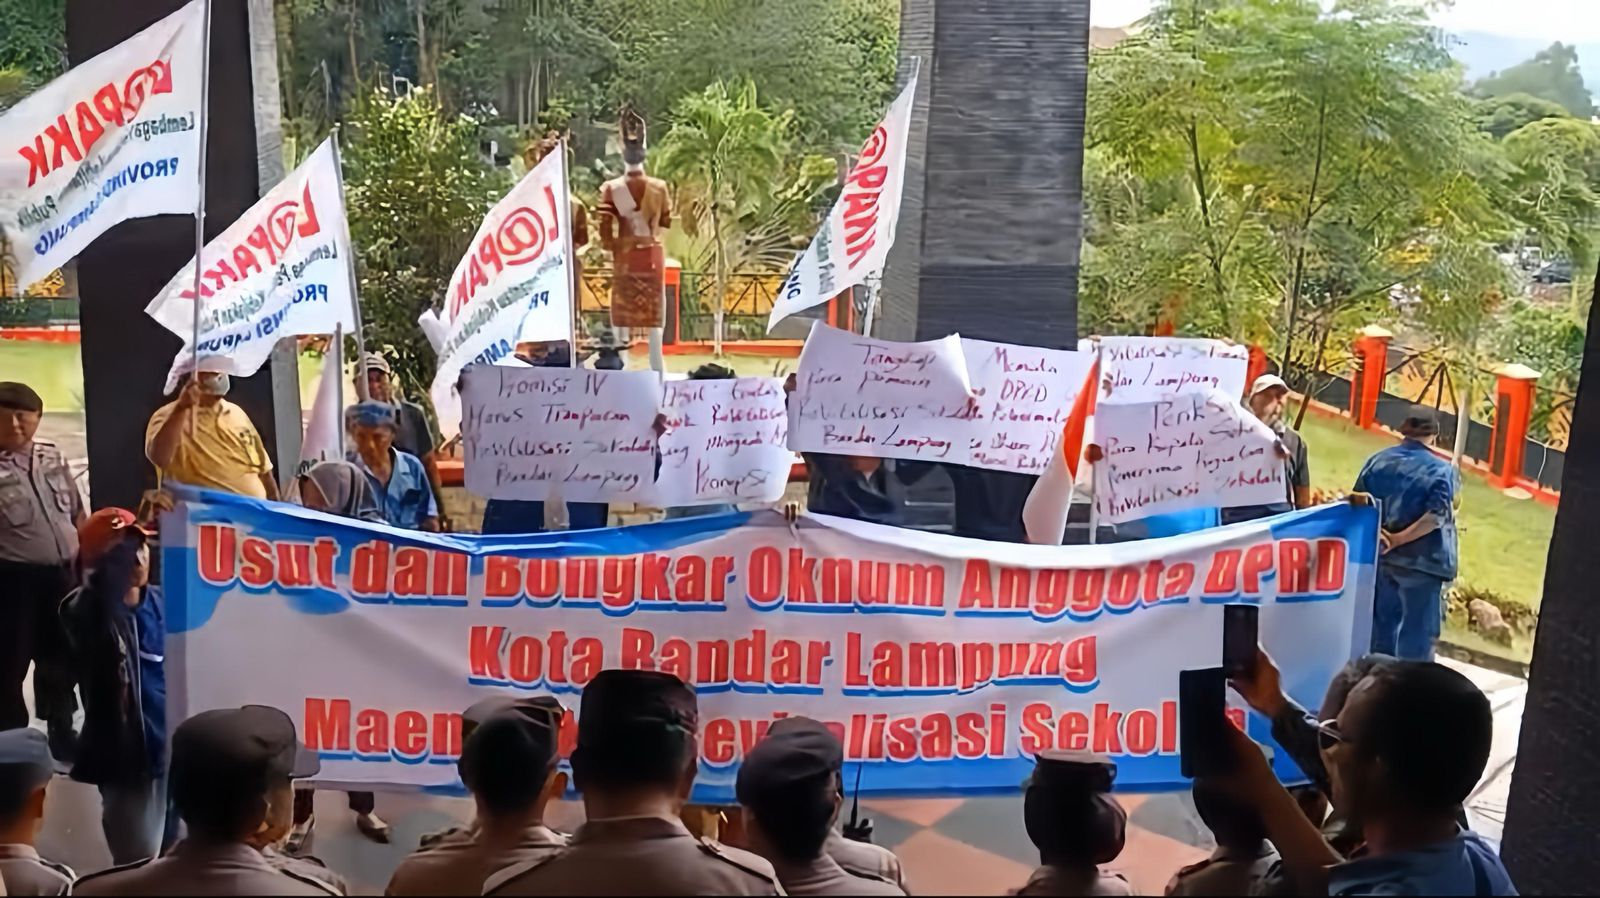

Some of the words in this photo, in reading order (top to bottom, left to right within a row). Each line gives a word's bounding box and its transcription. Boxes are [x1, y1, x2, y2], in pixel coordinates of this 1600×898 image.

[584, 373, 609, 397] IV
[199, 526, 334, 586] Usut
[352, 542, 466, 594] dan
[748, 546, 944, 606] Oknum
[959, 559, 1194, 614] Anggota
[1204, 541, 1344, 593] DPRD
[469, 626, 603, 684] Kota
[621, 627, 830, 684] Bandar
[844, 632, 1096, 688] Lampung
[1020, 701, 1178, 753] Sekol
